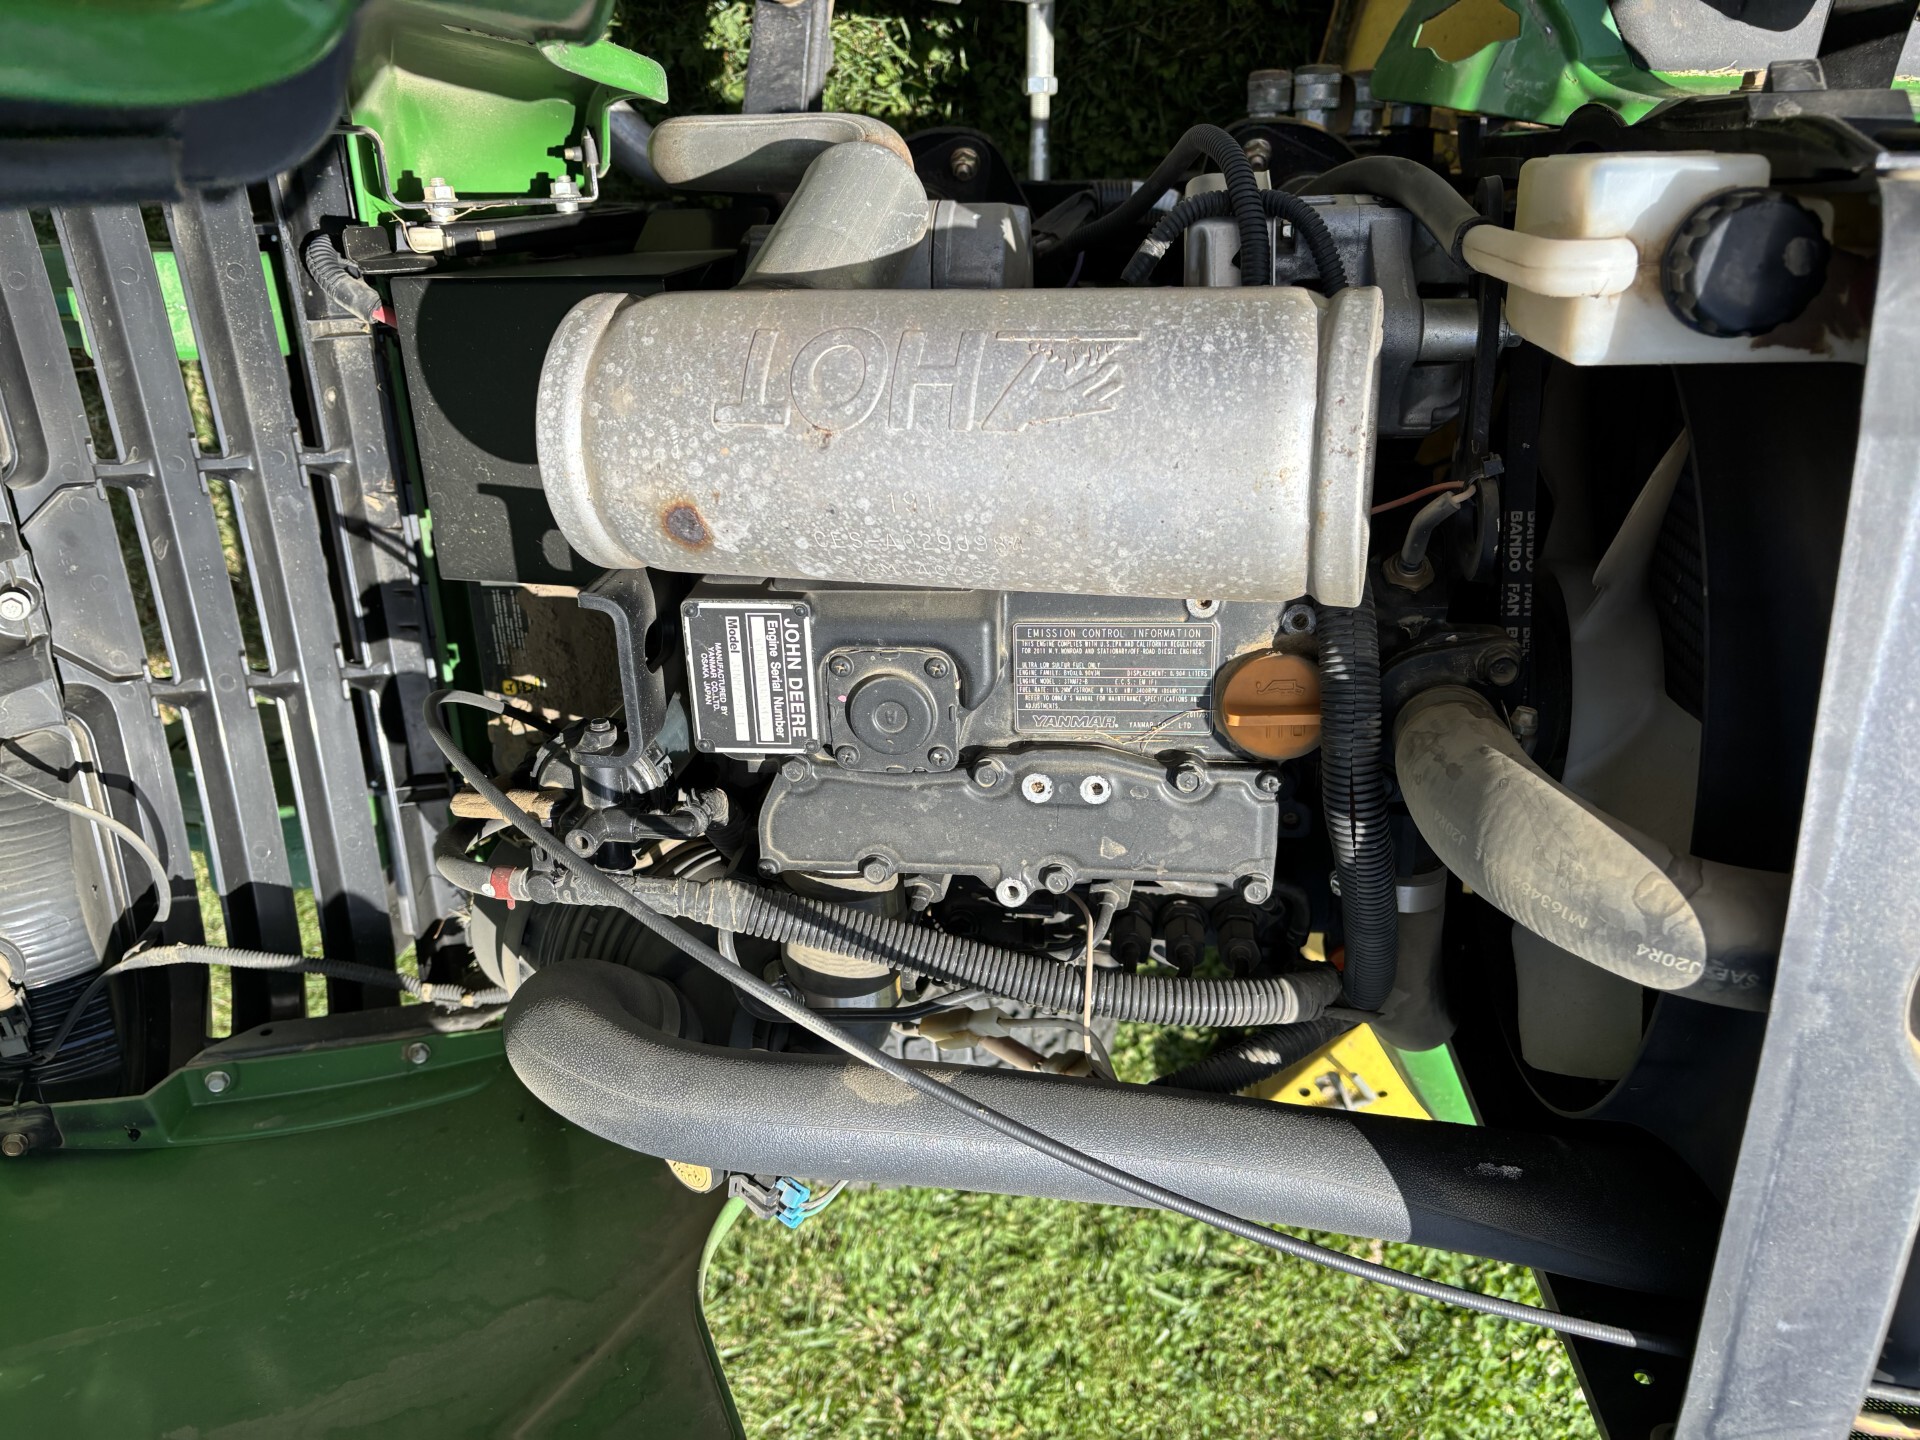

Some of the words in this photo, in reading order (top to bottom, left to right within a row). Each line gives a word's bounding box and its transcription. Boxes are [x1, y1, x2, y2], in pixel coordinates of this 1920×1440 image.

[712, 327, 989, 434] HOT
[1508, 510, 1523, 572] BANDO
[1506, 583, 1521, 617] FAN
[728, 618, 740, 653] Model
[766, 621, 778, 657] Engine
[784, 618, 801, 670] JOHN
[1027, 629, 1076, 638] EMISSION
[1082, 629, 1124, 638] CONTROL
[1133, 629, 1201, 638] INFORMATION
[701, 653, 709, 678] OSAKA
[708, 646, 716, 678] YANMAR
[715, 642, 727, 703] MANUFACTURED
[722, 706, 728, 716] BY
[770, 662, 782, 692] Serial
[703, 681, 711, 705] JAPAN
[788, 678, 807, 737] DEERE
[773, 697, 785, 738] Number
[1635, 942, 1701, 974] J20R4
